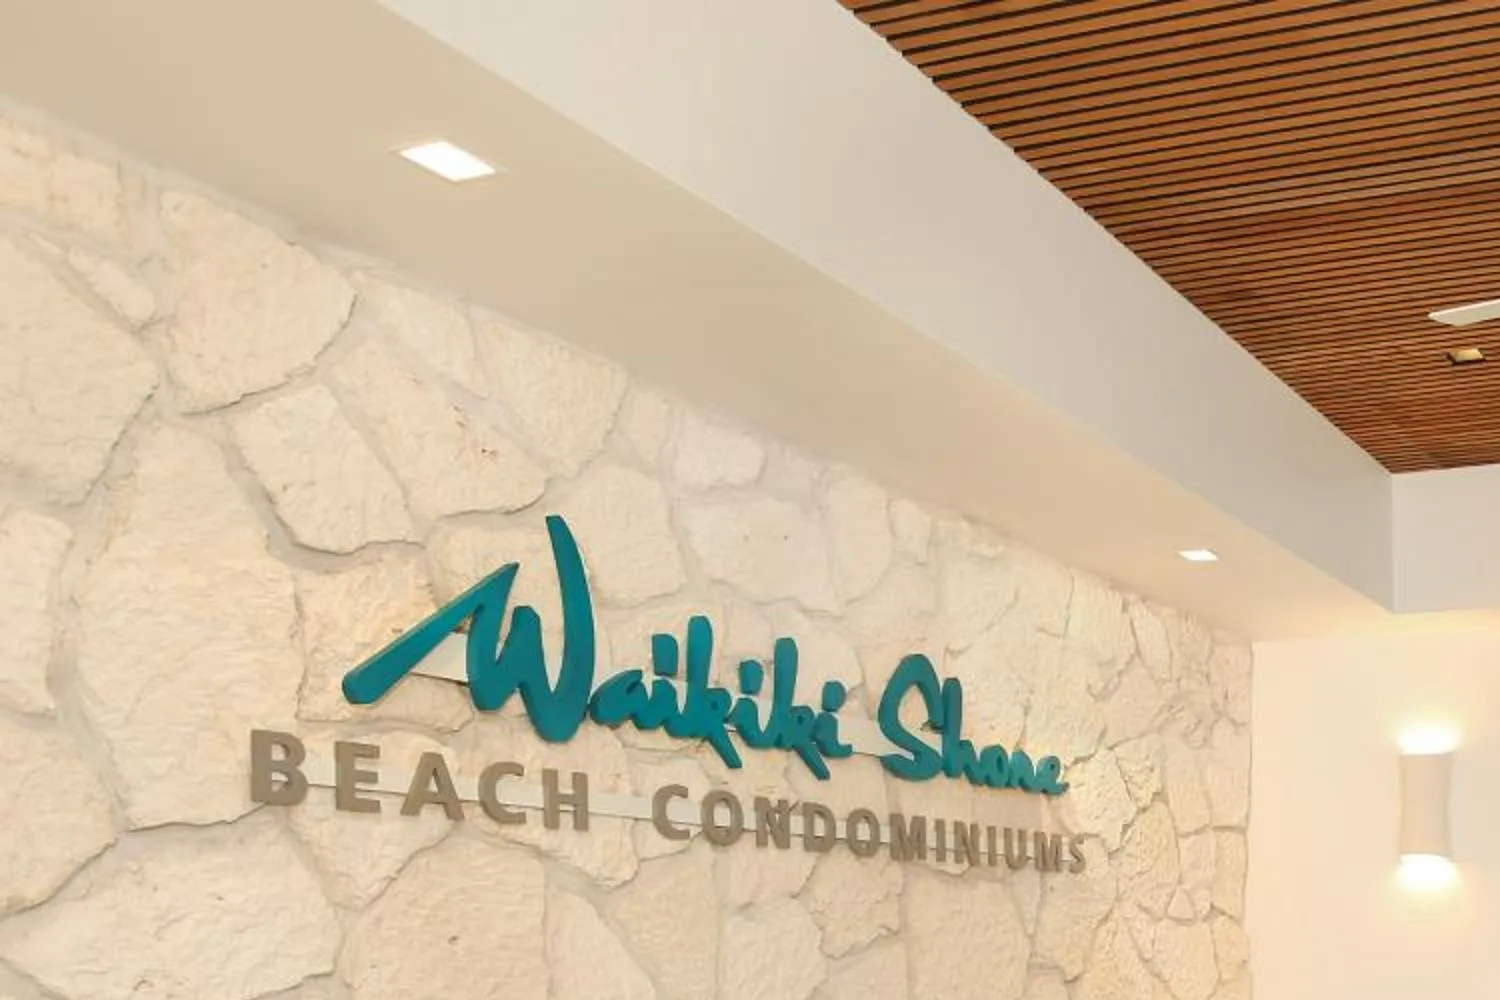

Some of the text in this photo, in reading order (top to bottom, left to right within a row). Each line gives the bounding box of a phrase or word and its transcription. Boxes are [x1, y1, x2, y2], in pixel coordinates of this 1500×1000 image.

[341, 515, 1070, 796] Waikiki Shore
[250, 729, 1086, 874] BEACH CONDOMINIUMS
